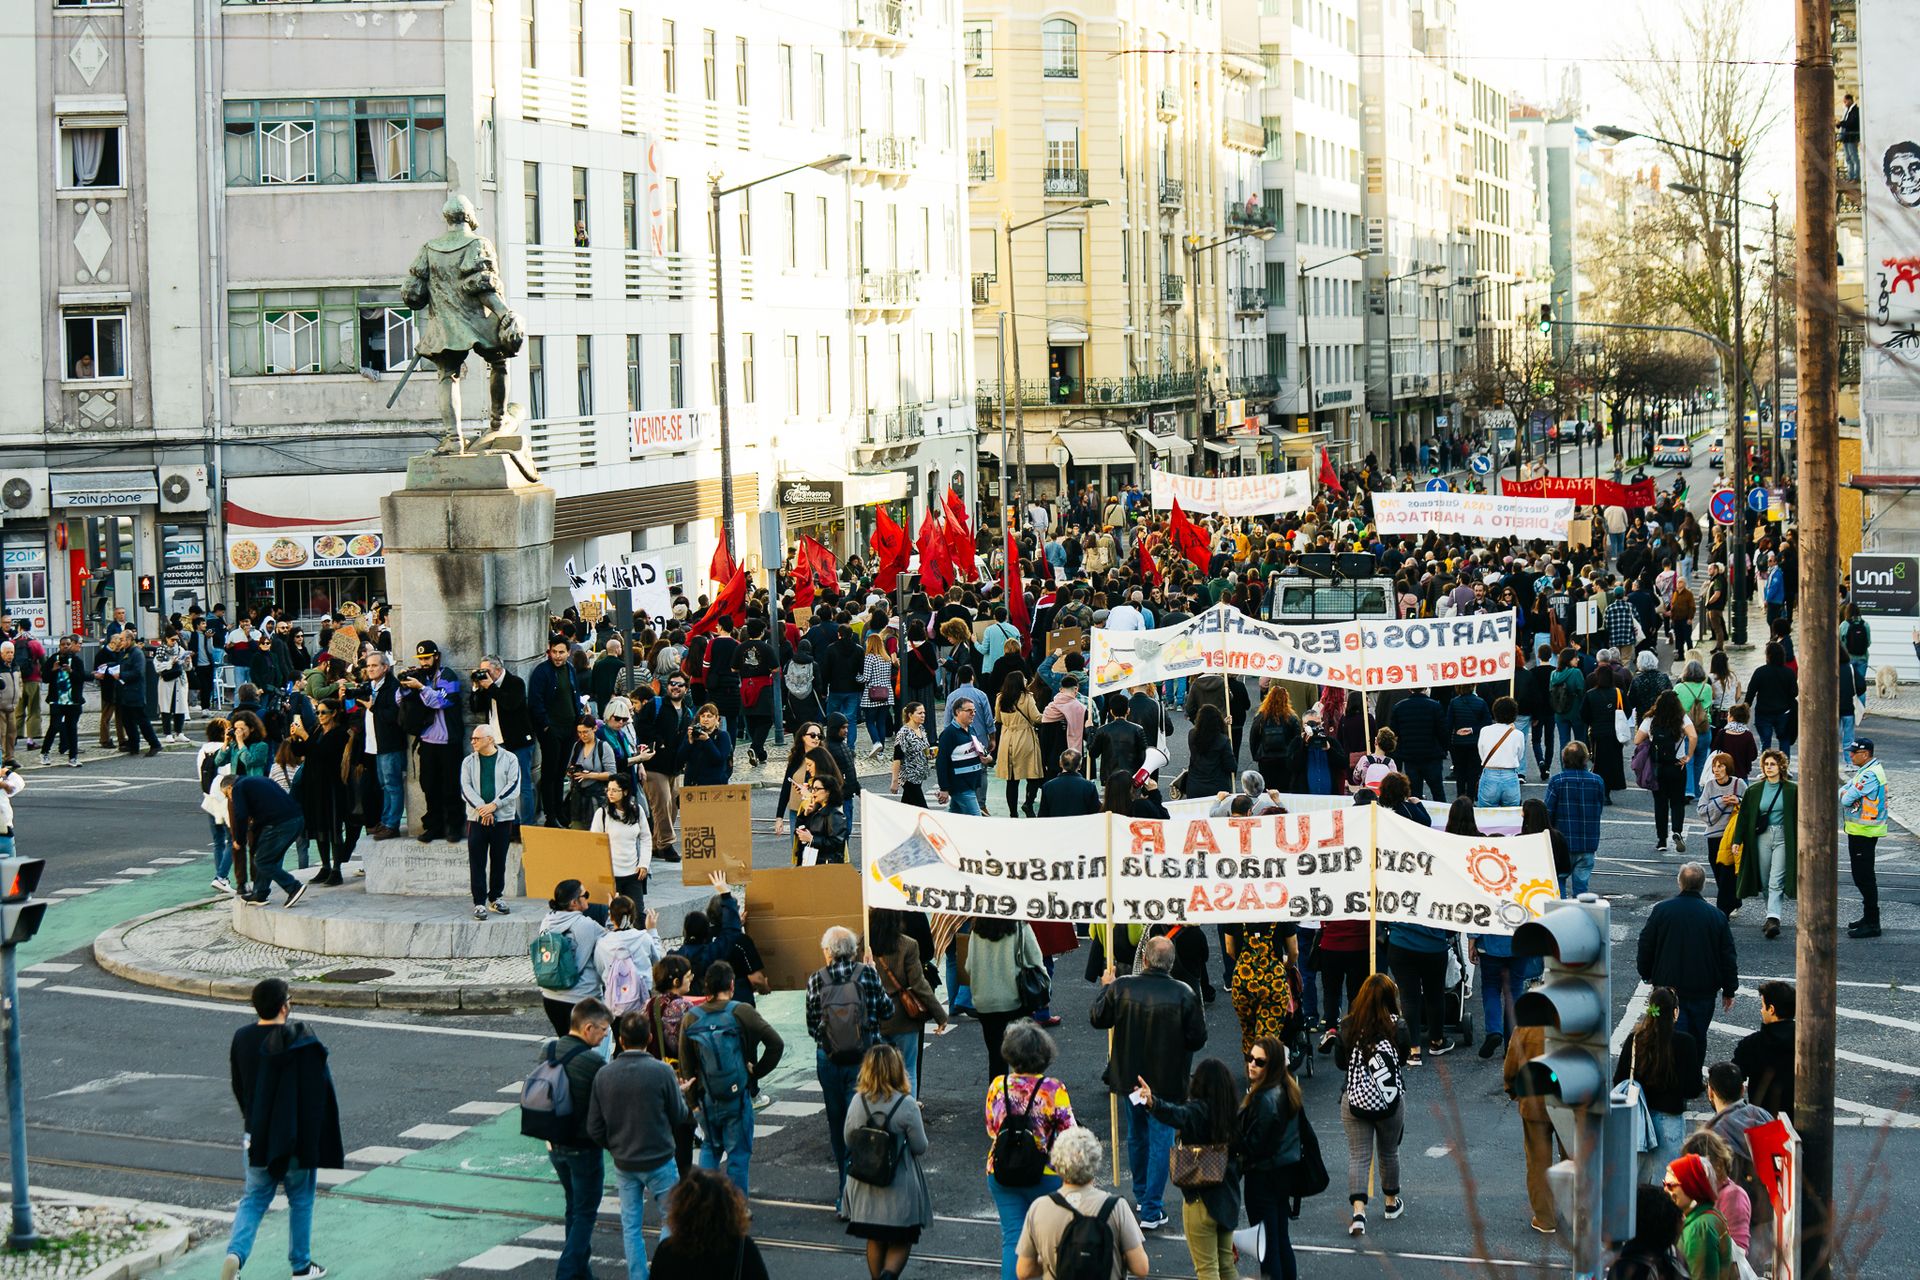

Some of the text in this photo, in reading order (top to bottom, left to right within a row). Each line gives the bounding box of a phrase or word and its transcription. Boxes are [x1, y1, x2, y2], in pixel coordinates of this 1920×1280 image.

[634, 415, 682, 444] VENDE-SE
[1781, 422, 1792, 437] P
[100, 493, 142, 506] phone
[313, 558, 365, 568] GALIFRANGO
[13, 607, 44, 615] iPhone
[1368, 1056, 1398, 1104] FILA
